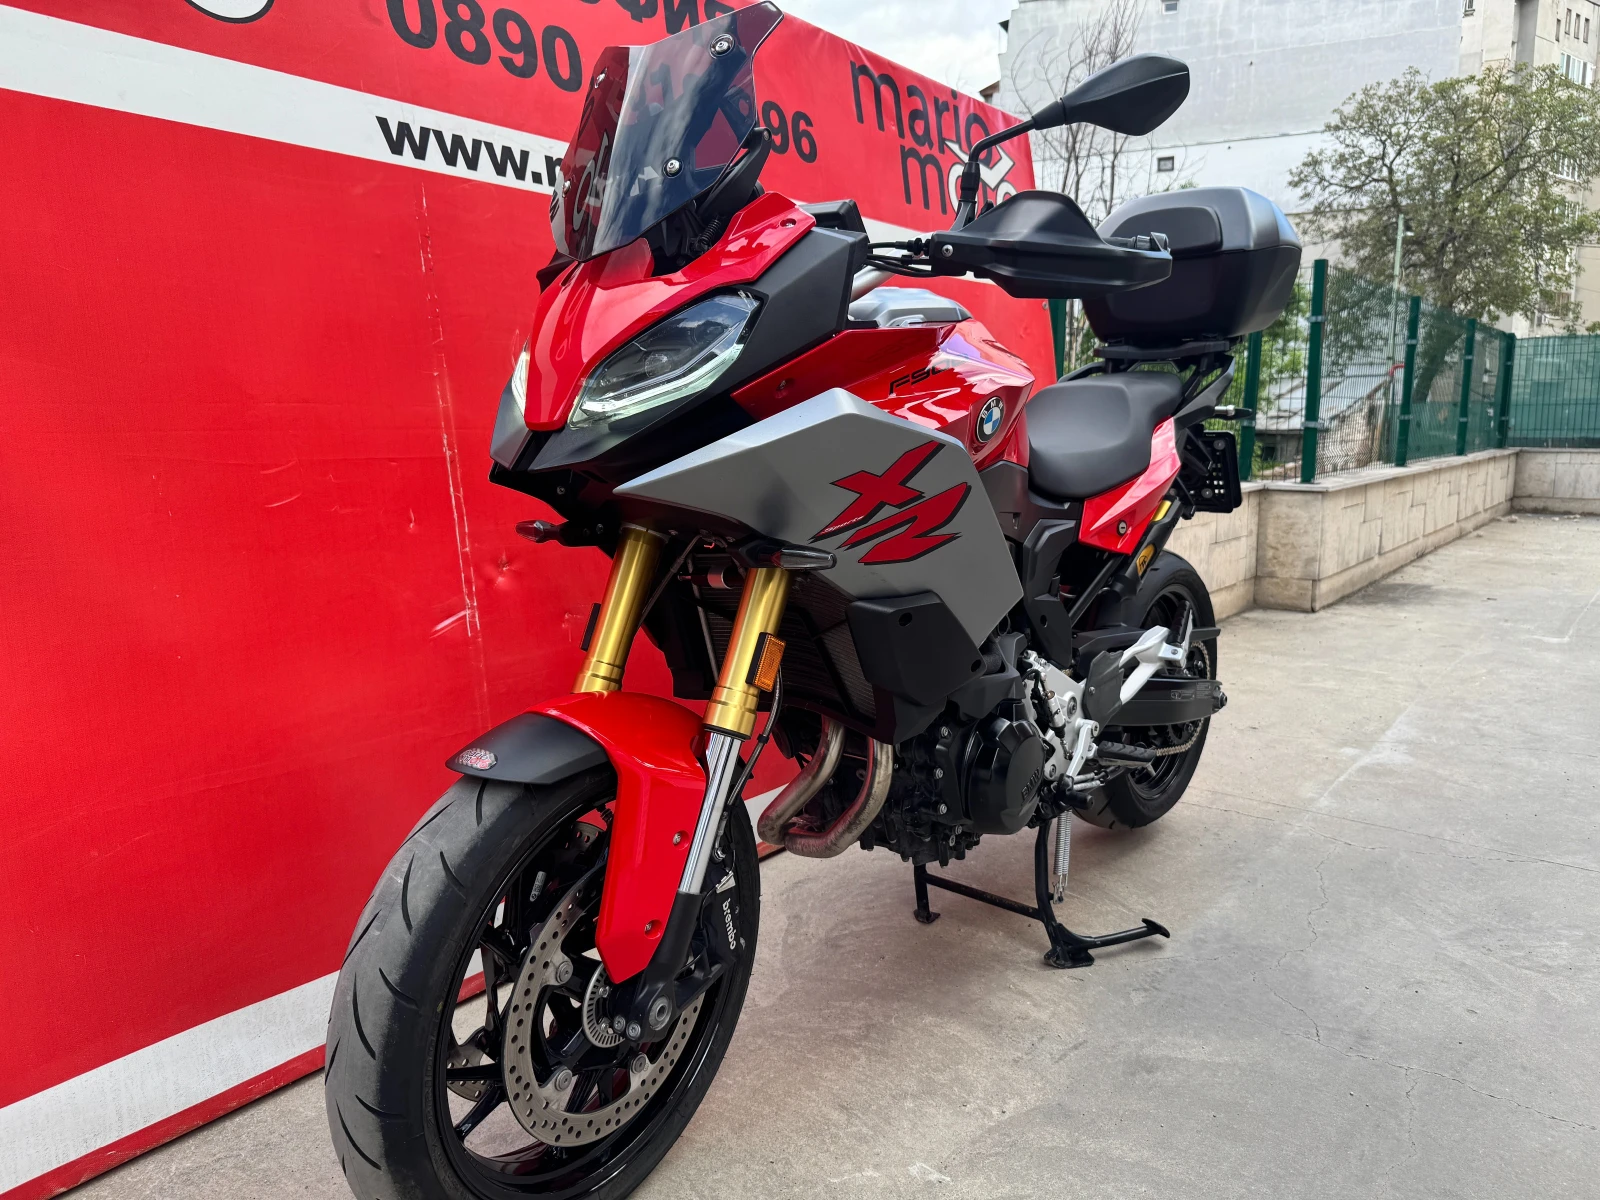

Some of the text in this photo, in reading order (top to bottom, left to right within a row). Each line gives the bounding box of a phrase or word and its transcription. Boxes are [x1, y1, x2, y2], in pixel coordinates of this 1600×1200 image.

[385, 0, 583, 93] 0890
[850, 60, 993, 167] mario
[722, 897, 738, 950] brembo
